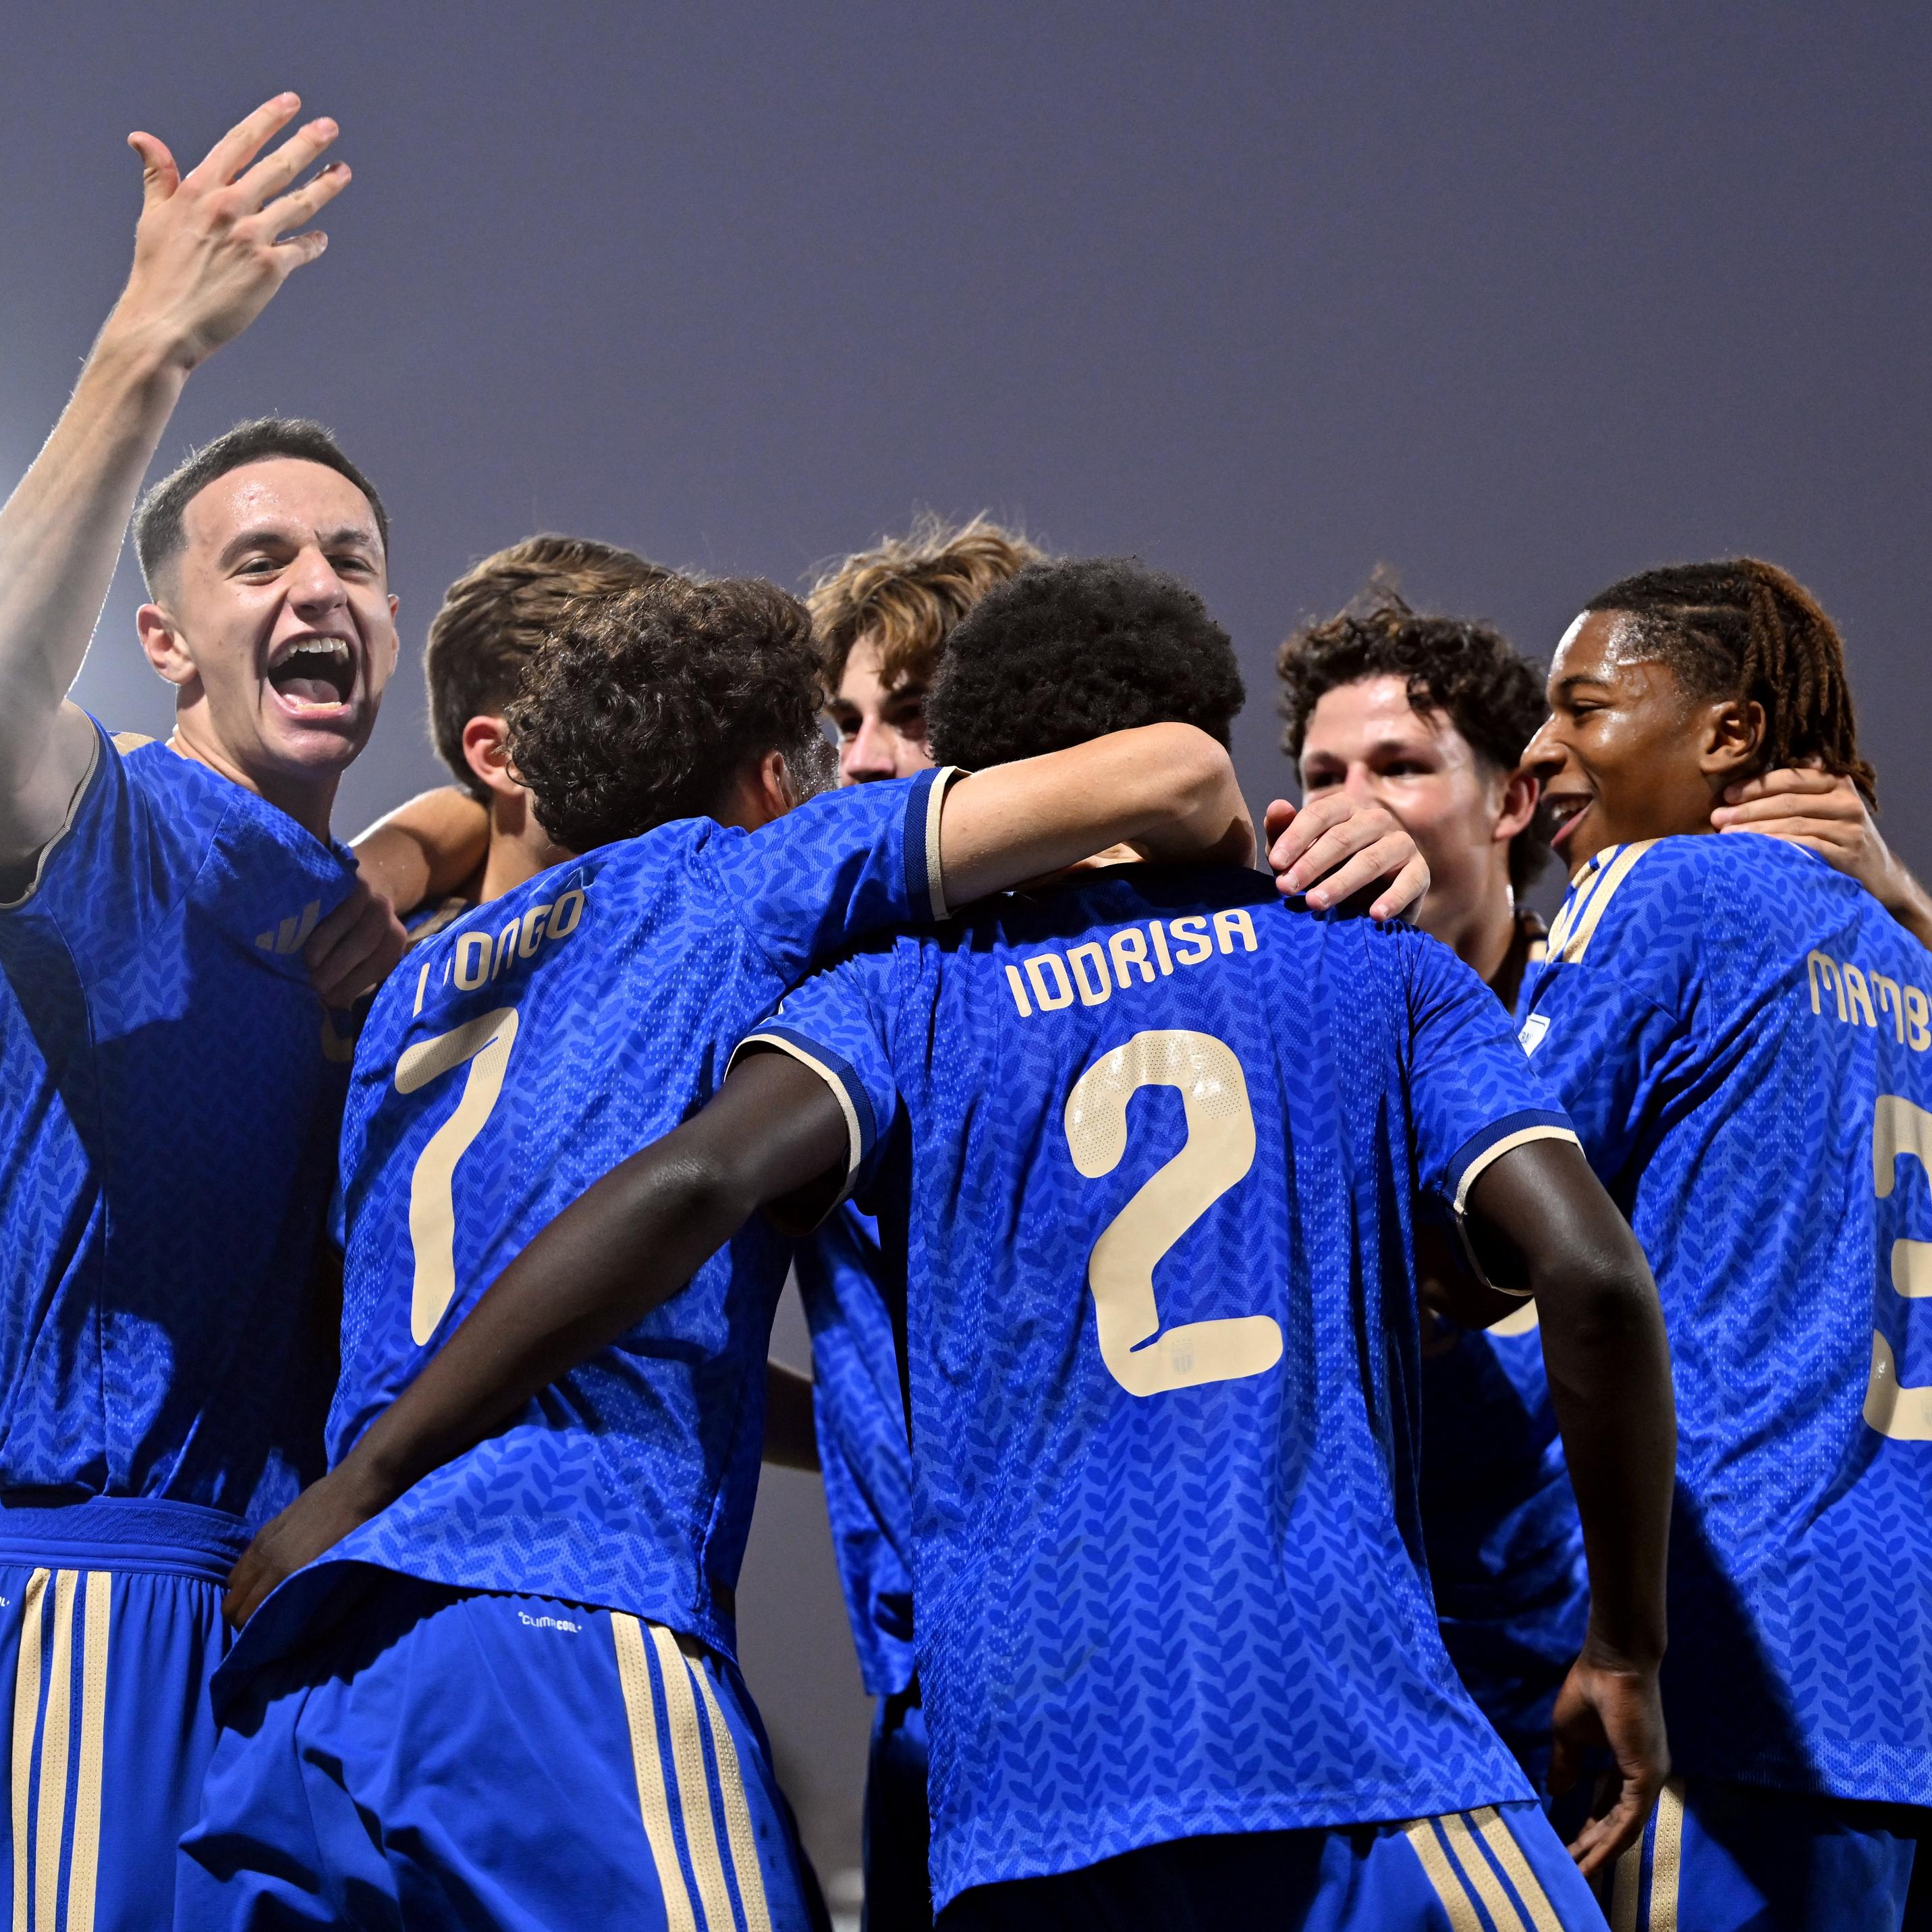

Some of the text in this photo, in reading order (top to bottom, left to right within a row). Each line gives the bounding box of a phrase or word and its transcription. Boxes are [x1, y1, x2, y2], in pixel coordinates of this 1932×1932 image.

[1005, 909, 1259, 1018] IDDRISA
[1807, 949, 1932, 1053] MAMB
[394, 1007, 519, 1346] 7
[1064, 1030, 1284, 1397] 2
